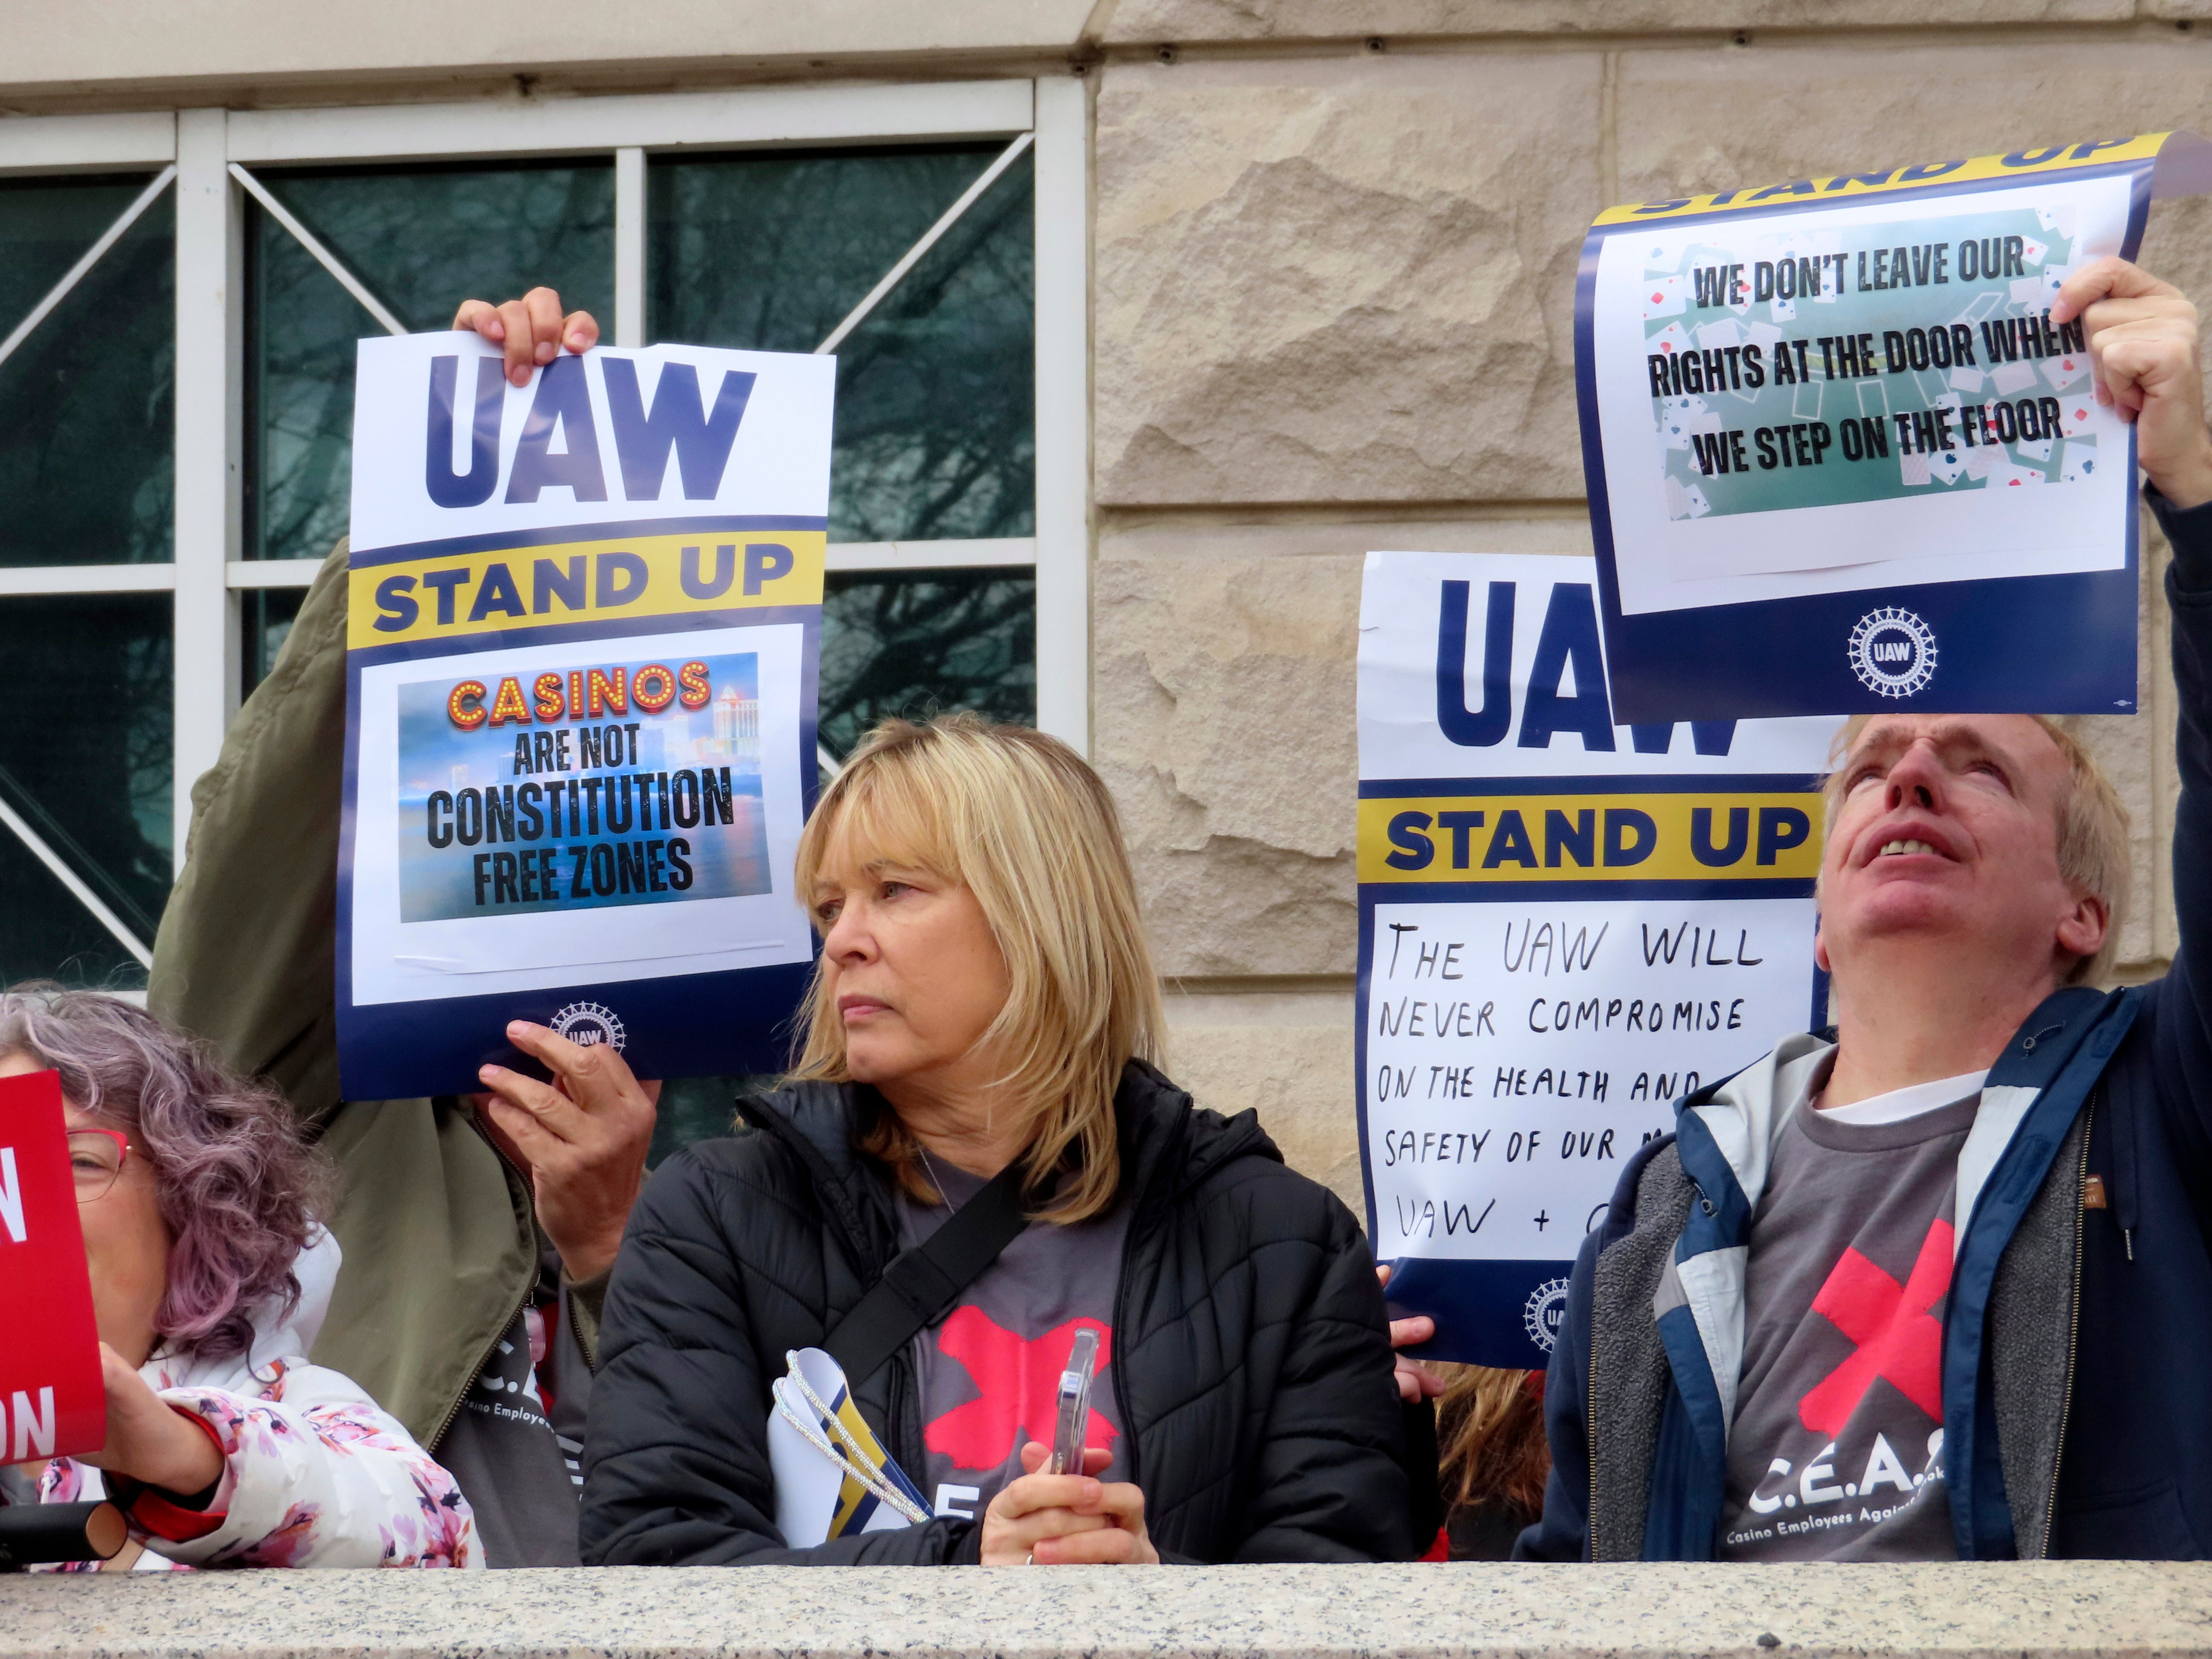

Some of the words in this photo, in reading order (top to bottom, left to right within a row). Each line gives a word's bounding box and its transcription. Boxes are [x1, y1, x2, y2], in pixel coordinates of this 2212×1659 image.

[1694, 264, 1744, 309] WE
[1754, 253, 1848, 303] DON'T
[1857, 243, 1949, 291] LEAVE
[1959, 235, 2024, 282] OUR
[1647, 344, 1765, 397] RIGHTS
[1774, 340, 1809, 386] AT
[1817, 333, 1877, 381] THE
[1883, 324, 1976, 373] DOOR
[1980, 314, 2086, 363] WHEN
[426, 355, 757, 508] UAW
[1692, 433, 1749, 476] WE
[1757, 422, 1831, 470] STEP
[1840, 416, 1889, 462] ON
[1893, 408, 1955, 456] THE
[1962, 396, 2064, 448] FLOOR
[373, 551, 649, 632] STAND
[680, 543, 794, 600] UP
[1437, 580, 1738, 756] UA
[1874, 642, 1910, 661] UAW
[447, 660, 711, 731] CASINOS
[513, 729, 570, 775] ARE
[581, 723, 640, 769] NOT
[427, 767, 734, 848] CONSTITUTION
[1385, 807, 1657, 871] STAND
[1691, 806, 1810, 867] UP
[474, 848, 559, 906] FREE
[568, 838, 693, 898] ZONES
[1389, 923, 1464, 980] THE
[1504, 918, 1609, 977] UAW
[1642, 921, 1763, 968] WILL
[1380, 996, 1495, 1037] NEVER
[1529, 998, 1744, 1033] COMPROMISE
[1378, 1065, 1416, 1102] ON
[1430, 1066, 1475, 1100] THE
[1493, 1066, 1609, 1103] HEALTH
[1630, 1071, 1700, 1102] AND
[1385, 1129, 1491, 1166] SAFETY
[1507, 1129, 1541, 1162] OF
[1561, 1128, 1615, 1160] OUR
[1548, 1310, 1565, 1326] UA
[0, 1385, 56, 1460] N
[1727, 1528, 1772, 1545] Casino
[1777, 1511, 1852, 1536] Employees
